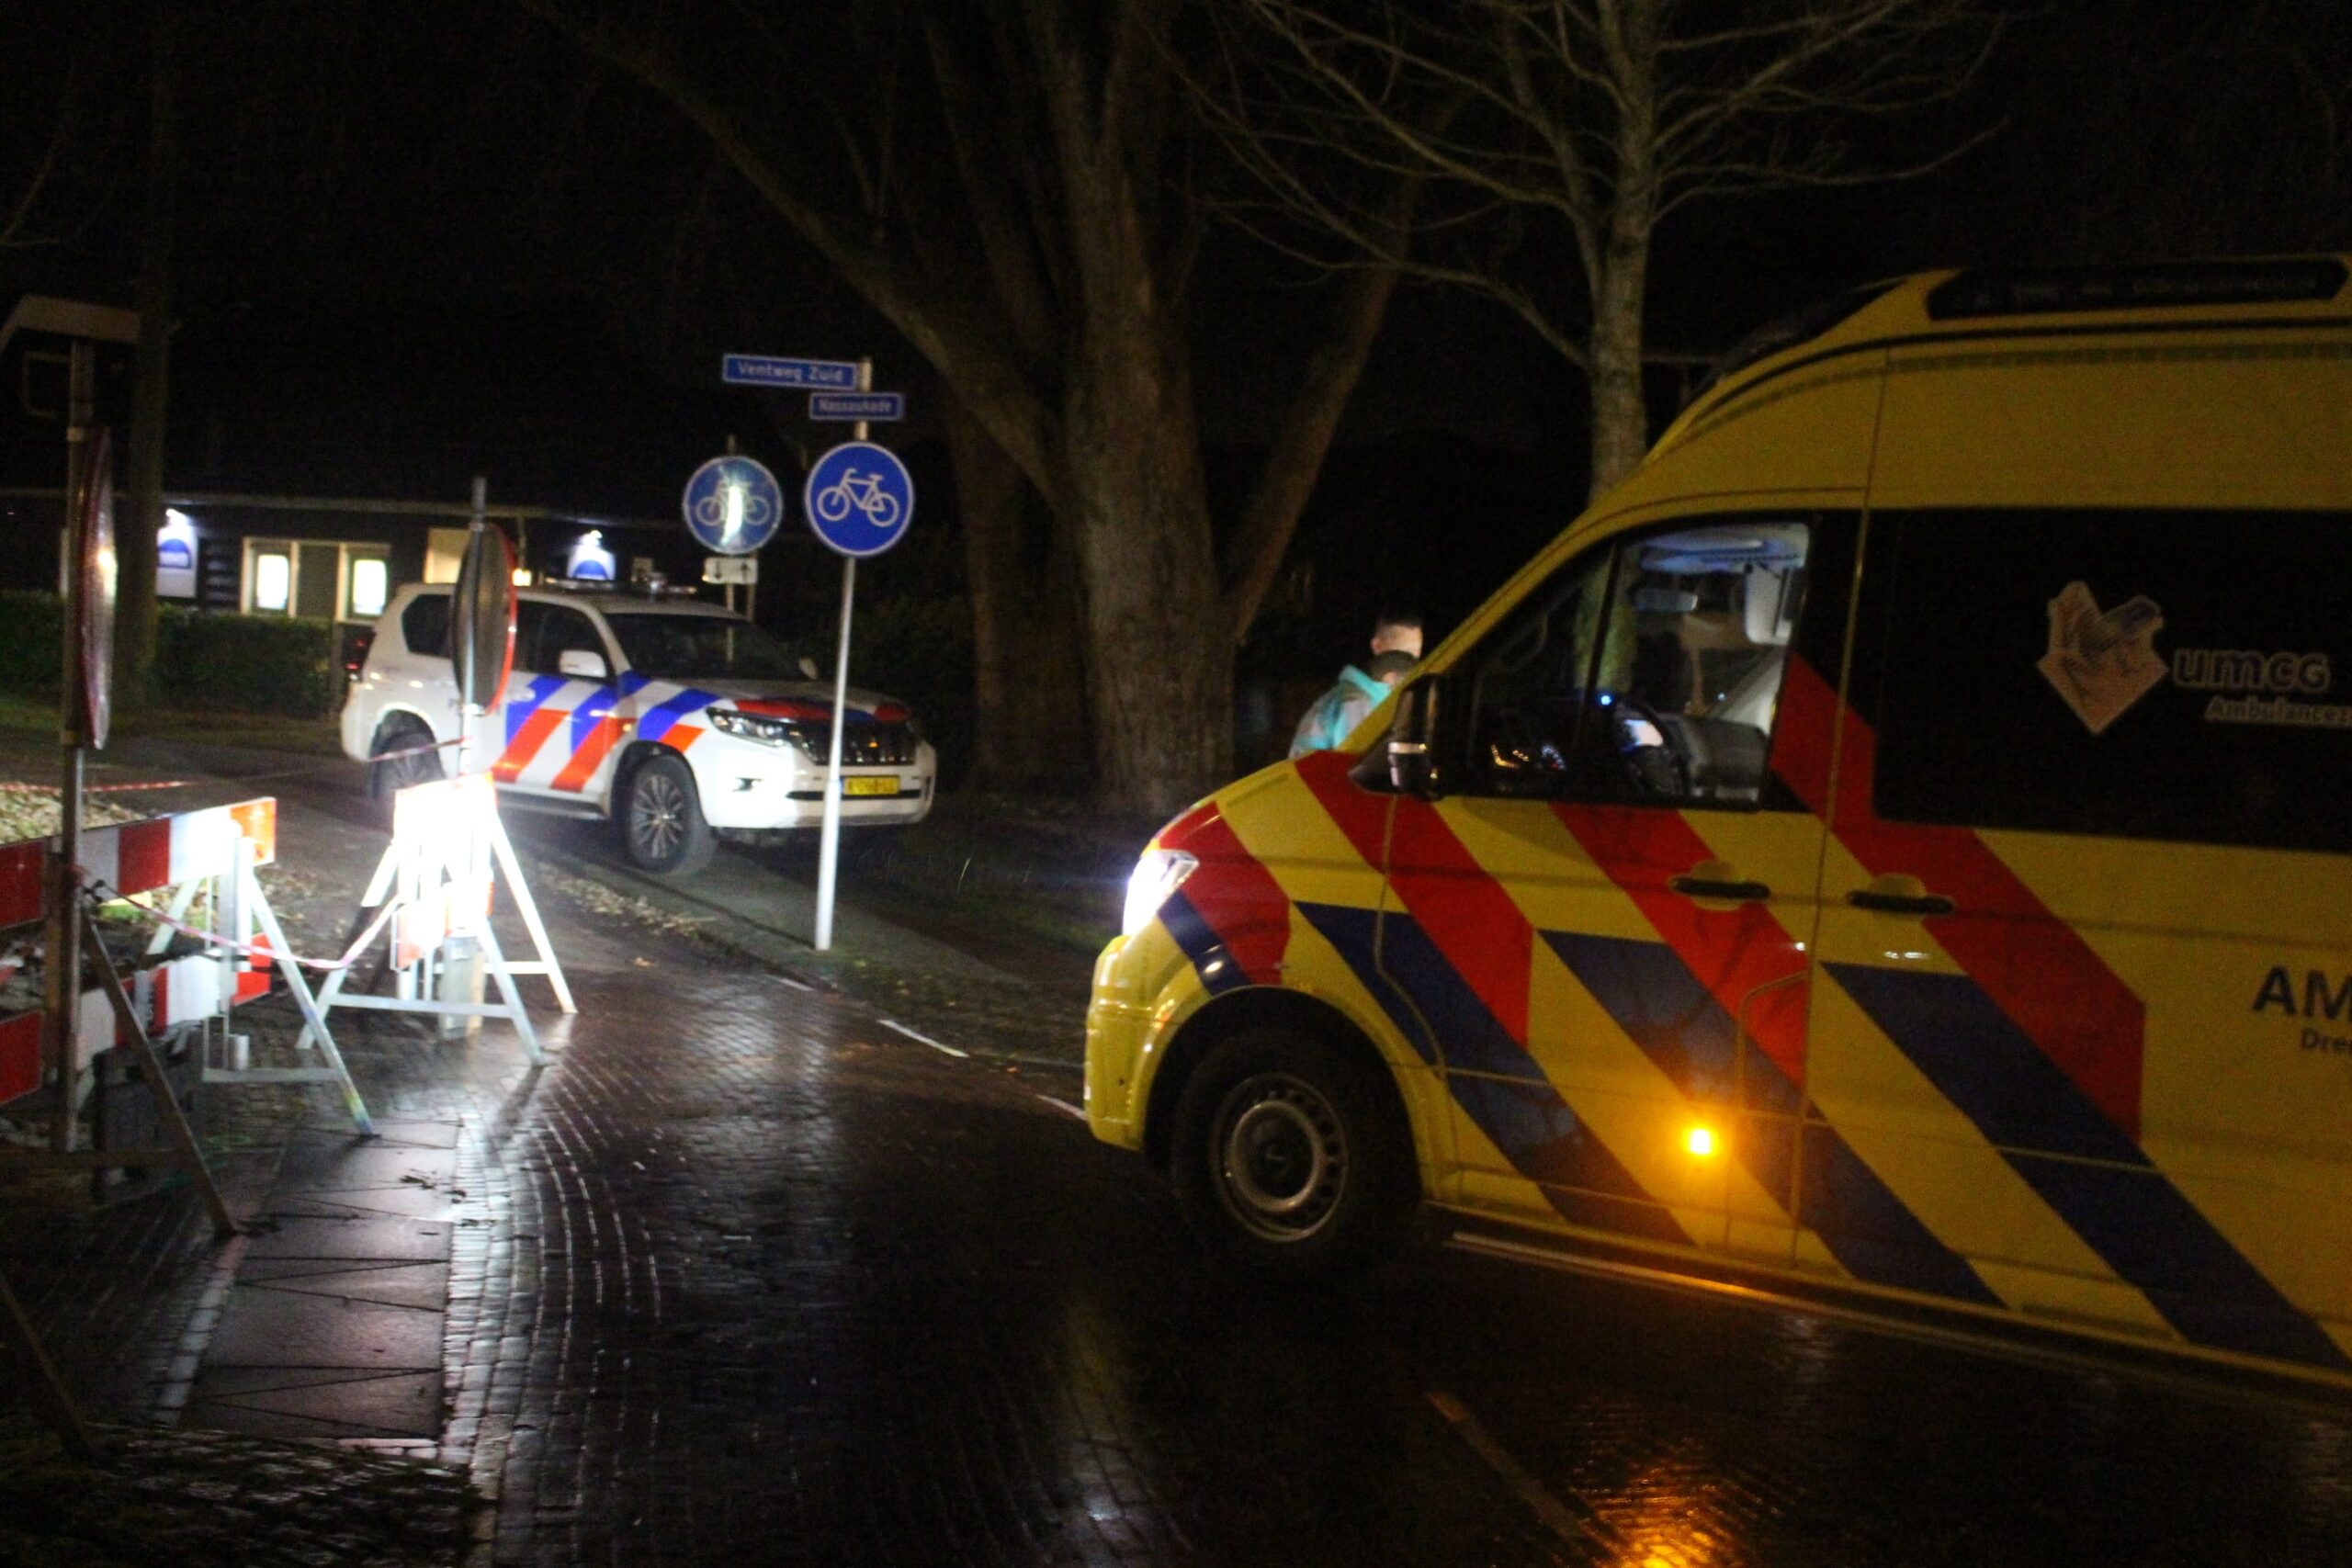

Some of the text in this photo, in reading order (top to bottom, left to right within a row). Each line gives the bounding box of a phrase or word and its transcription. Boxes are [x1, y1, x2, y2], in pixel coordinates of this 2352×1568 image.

[738, 361, 842, 383] Ventweg Zuid
[2253, 965, 2352, 1020] AM
[2301, 1028, 2352, 1052] Dre
